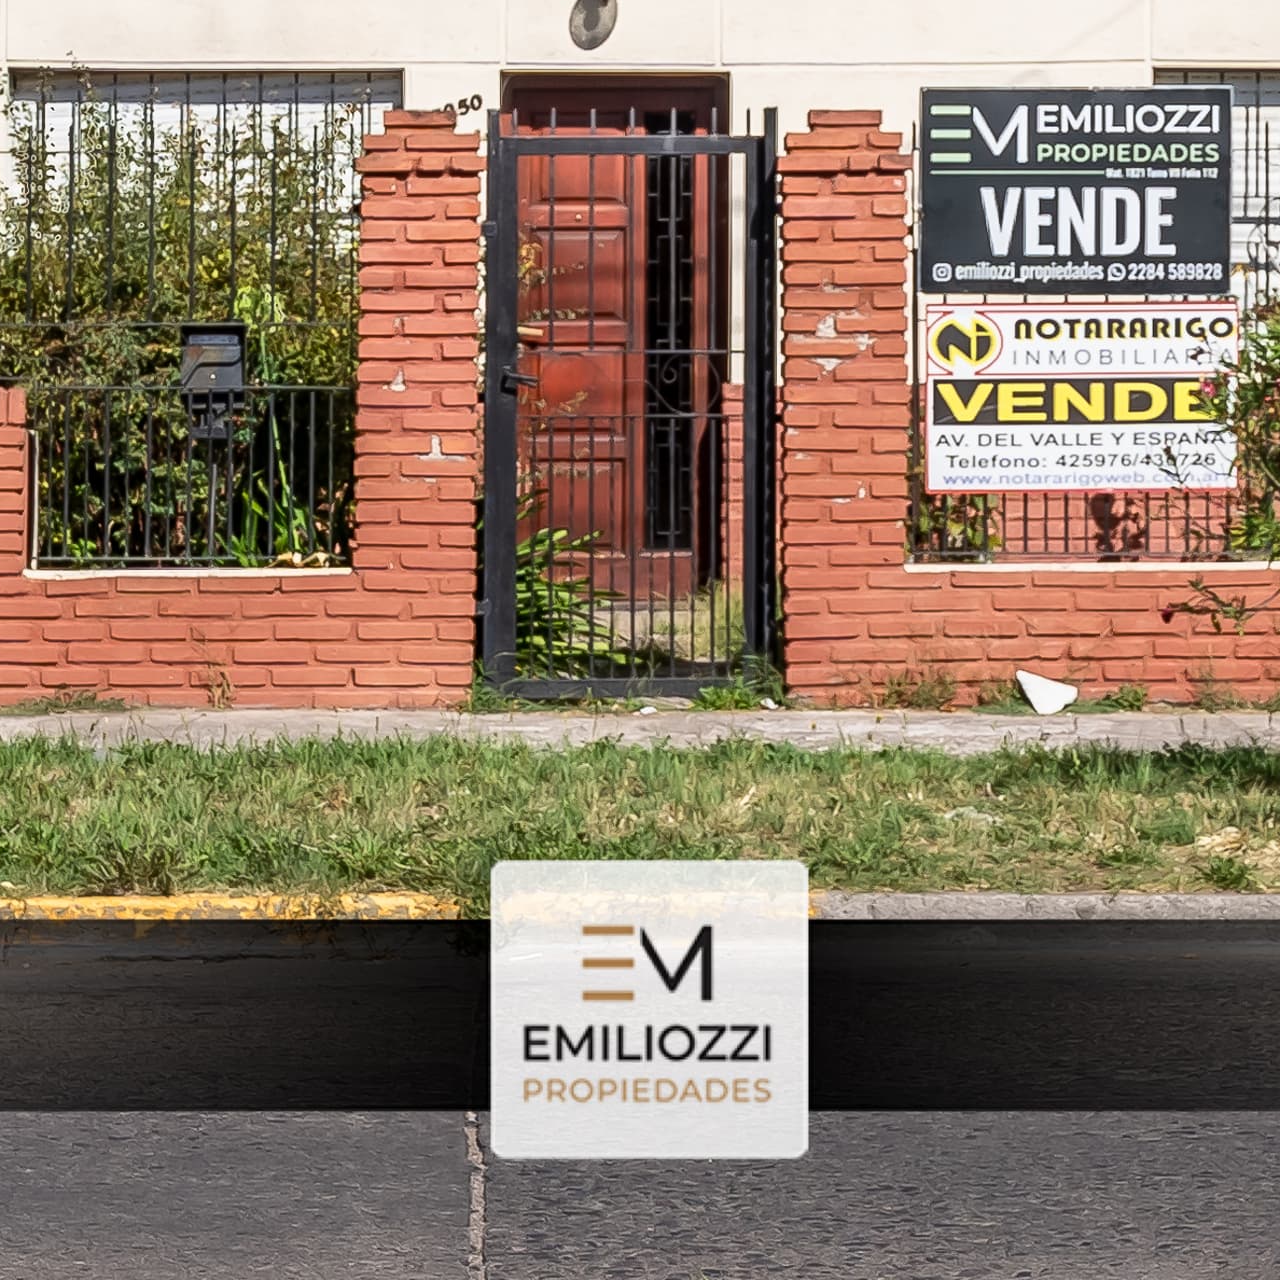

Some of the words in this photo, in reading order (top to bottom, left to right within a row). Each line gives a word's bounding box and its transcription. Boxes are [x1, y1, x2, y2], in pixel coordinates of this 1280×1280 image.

[1035, 104, 1220, 134] EMILIOZZI
[1035, 142, 1220, 163] PROPIEDADES
[979, 186, 1178, 257] VENDE
[1127, 262, 1165, 281] 2284
[1013, 316, 1235, 340] NOTARARIGO
[935, 381, 1218, 422] VENDE
[935, 432, 969, 447] AV.
[977, 432, 1023, 447] DEL
[1030, 431, 1103, 447] VALLE
[1111, 431, 1125, 446] Y
